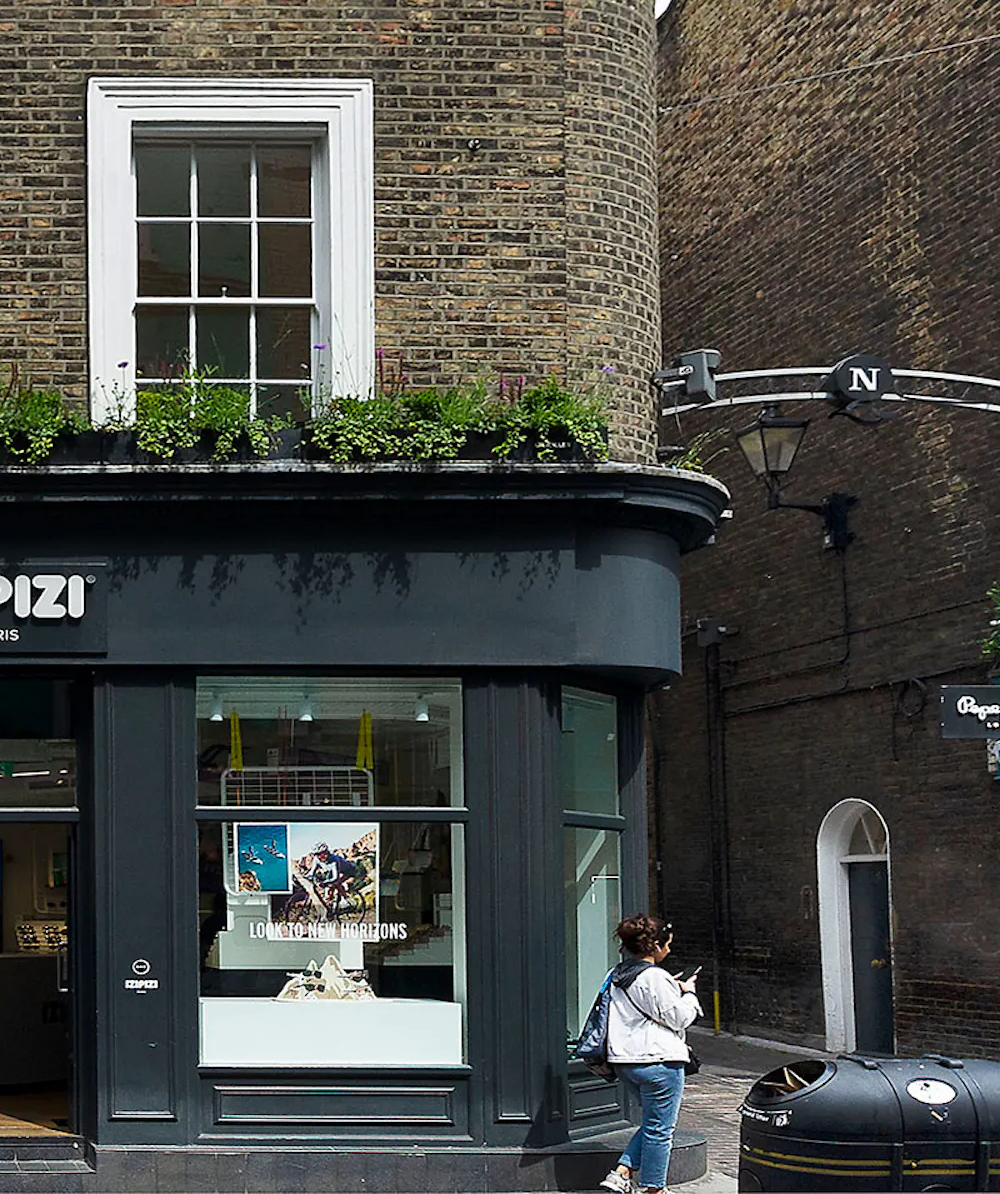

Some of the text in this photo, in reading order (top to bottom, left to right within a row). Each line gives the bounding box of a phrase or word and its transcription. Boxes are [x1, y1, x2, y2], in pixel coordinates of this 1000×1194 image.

[849, 367, 881, 391] N
[249, 922, 408, 939] LOOK TO NEW HORIZONS
